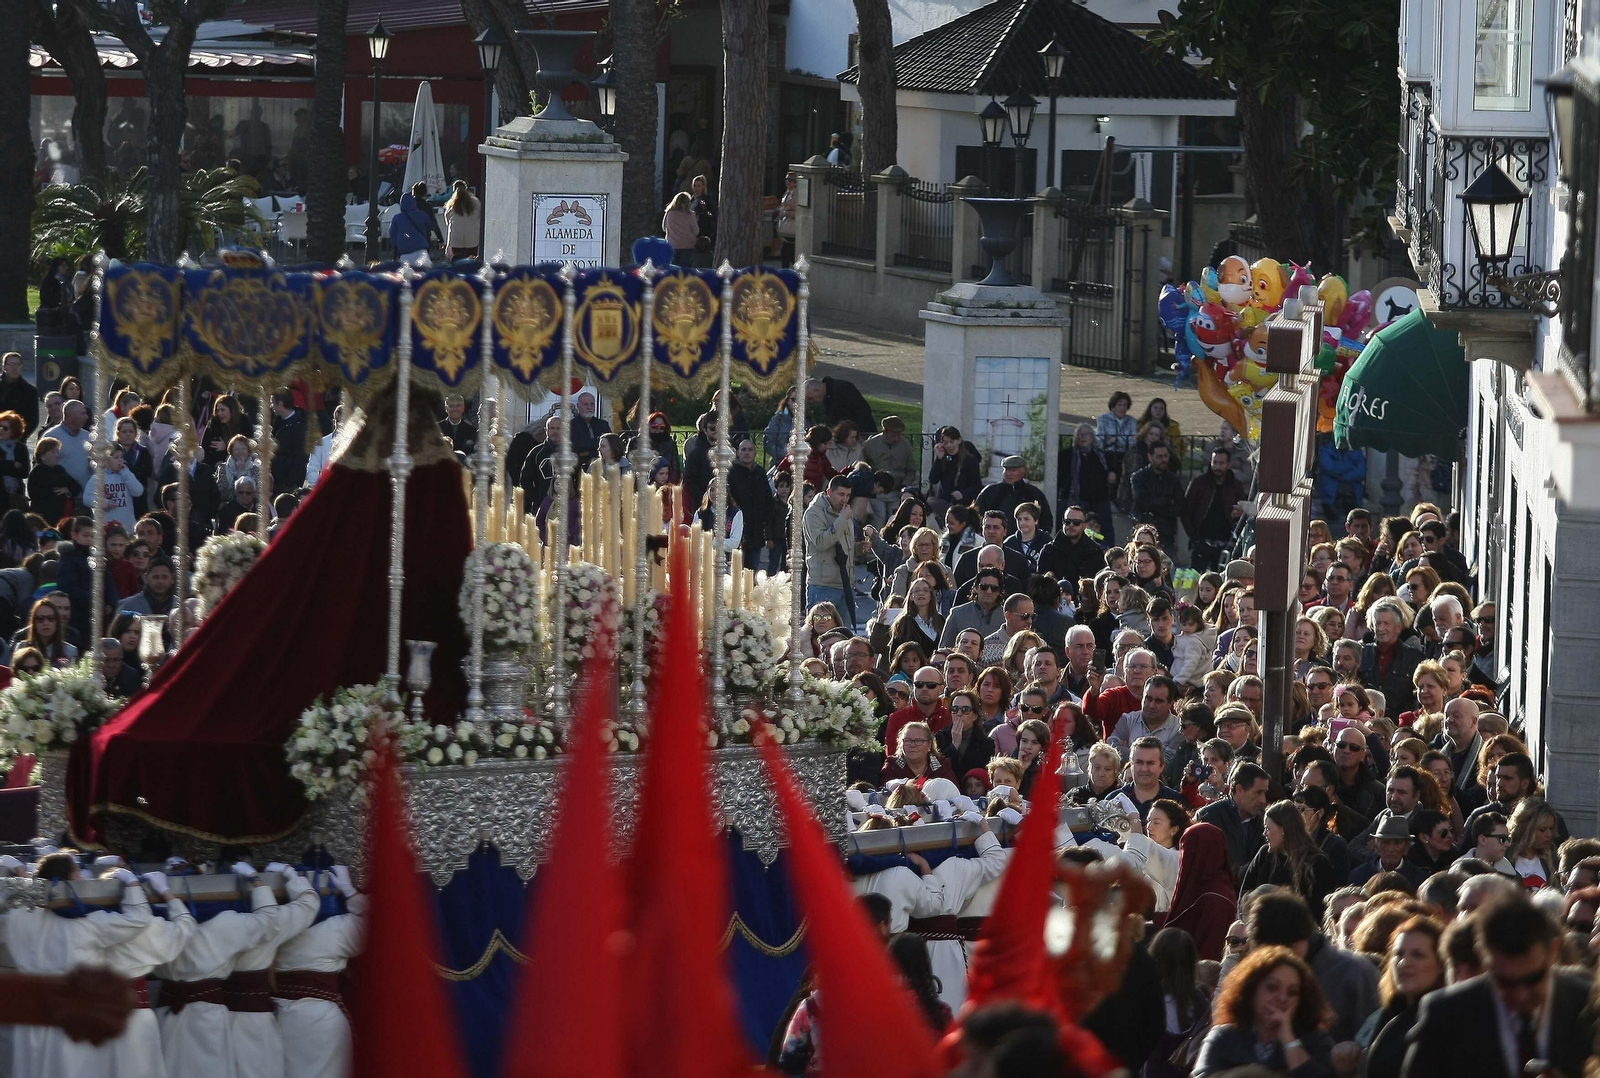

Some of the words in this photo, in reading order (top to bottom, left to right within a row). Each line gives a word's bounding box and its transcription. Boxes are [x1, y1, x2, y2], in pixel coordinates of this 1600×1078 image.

[545, 228, 594, 239] ALAMEDA
[562, 243, 576, 255] DE
[104, 482, 126, 493] GOOD
